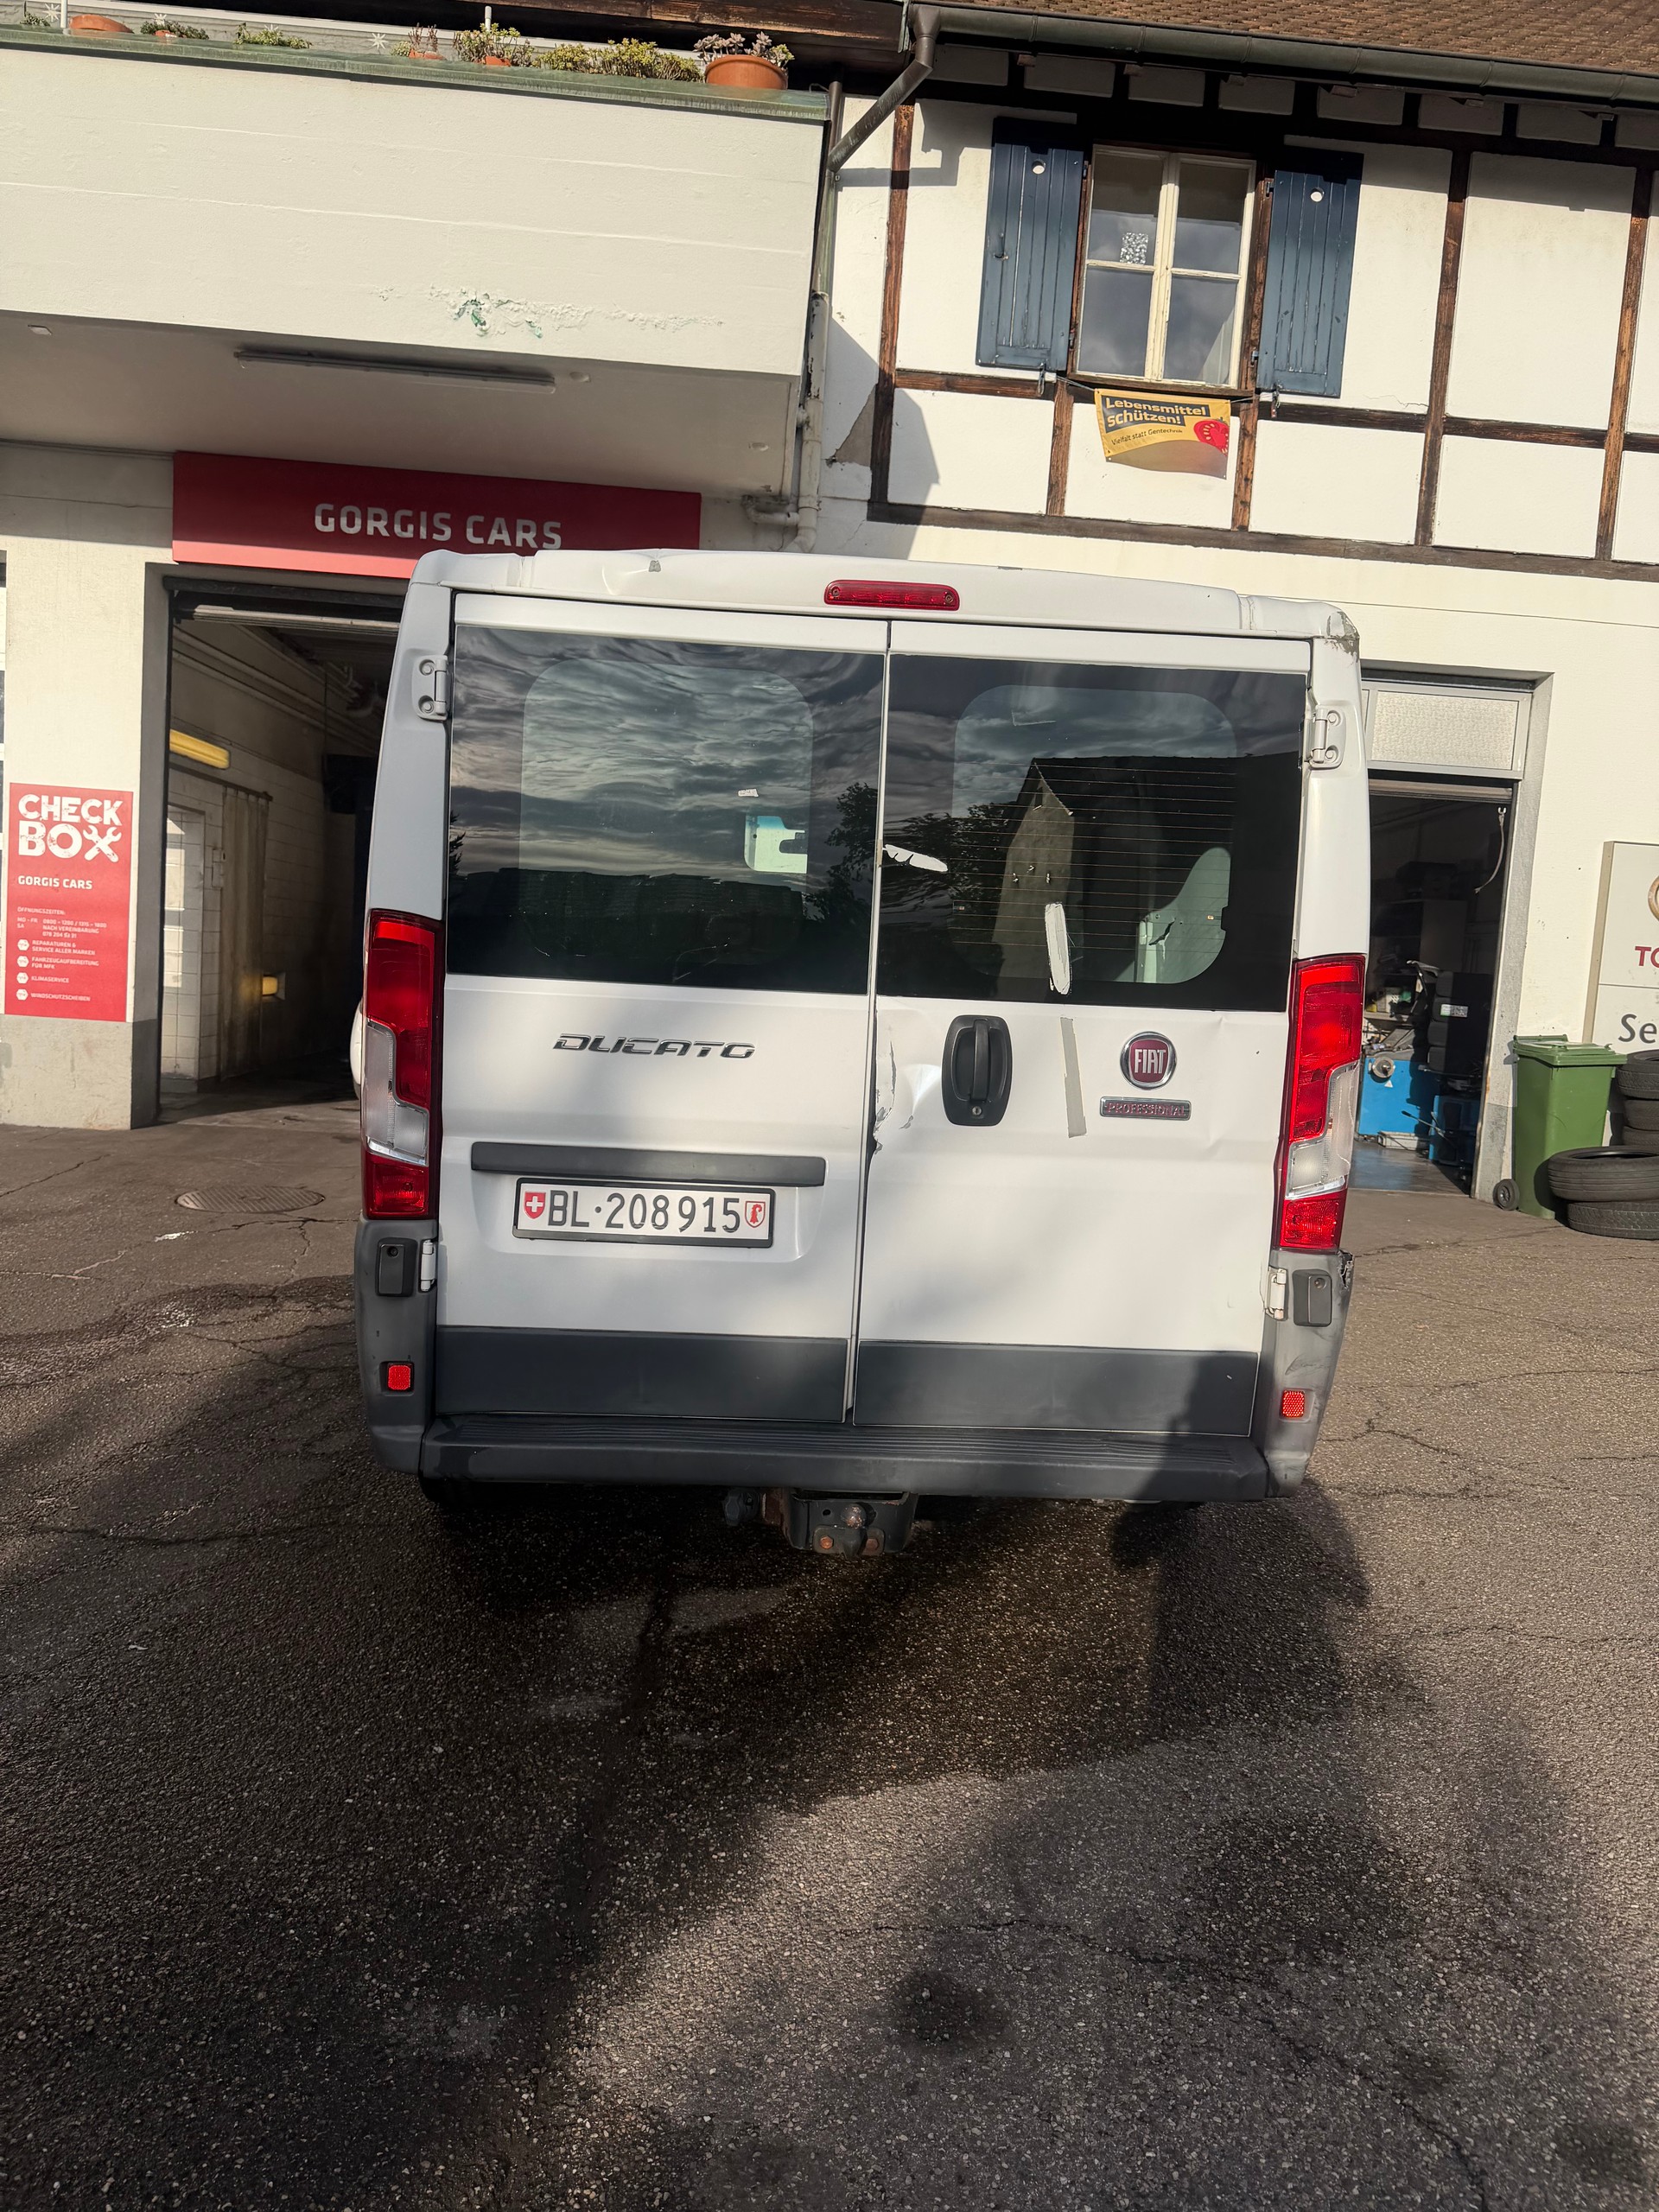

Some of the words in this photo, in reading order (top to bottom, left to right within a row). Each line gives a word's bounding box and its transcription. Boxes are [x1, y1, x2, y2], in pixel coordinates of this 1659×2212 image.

[1105, 397, 1206, 416] Lebensmittel
[1111, 435, 1131, 446] Vielfalt
[1132, 430, 1147, 440] statt
[315, 503, 452, 542] GORGIS
[466, 515, 563, 550] CARS
[18, 794, 124, 826] CHECK
[17, 875, 60, 887] GORGIS
[62, 878, 93, 890] CARS
[552, 1033, 756, 1059] DUCATO
[1134, 1048, 1166, 1074] FIAT
[1107, 1103, 1187, 1116] PROFESSIONAL
